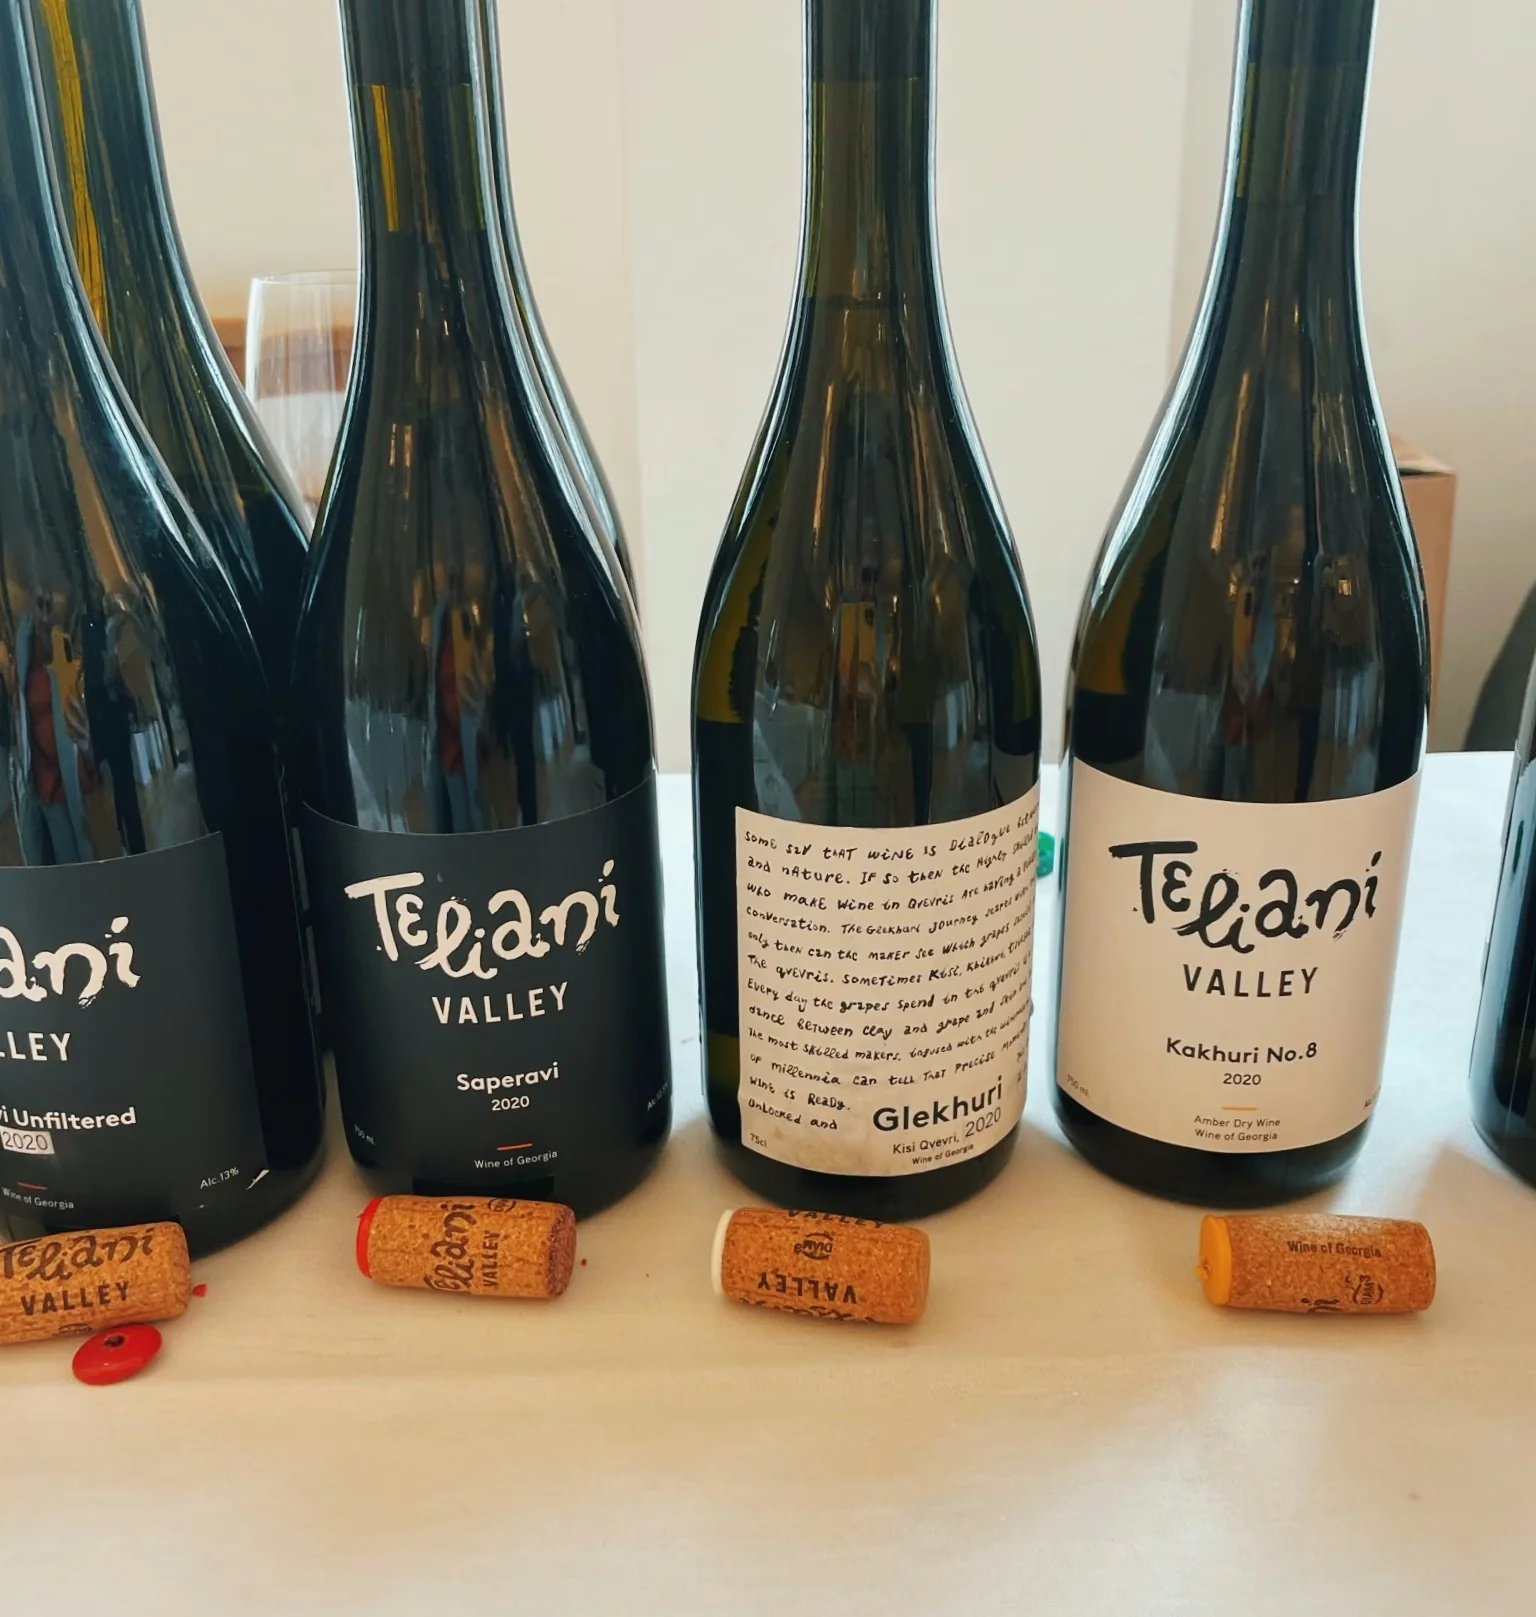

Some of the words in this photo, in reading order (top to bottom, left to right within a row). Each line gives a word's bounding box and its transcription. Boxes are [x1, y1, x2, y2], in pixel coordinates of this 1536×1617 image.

[747, 856, 771, 873] and
[952, 863, 970, 876] the
[882, 899, 900, 911] in
[748, 931, 770, 949] only
[808, 948, 832, 959] can
[837, 949, 858, 961] the
[980, 922, 1010, 948] grapes
[1183, 964, 1318, 998] VALLEY
[432, 981, 568, 1024] VALLEY
[747, 977, 779, 1001] Every
[785, 991, 808, 1013] day
[813, 996, 833, 1010] the
[840, 1001, 890, 1014] grapes
[942, 993, 958, 1005] in
[749, 1005, 785, 1025] dance
[862, 1025, 892, 1040] clay
[904, 1023, 928, 1035] and
[936, 1015, 970, 1034] grape
[976, 1001, 995, 1019] and
[0, 1030, 71, 1062] LEY
[768, 1035, 798, 1051] most
[909, 1042, 953, 1058] infused
[1166, 1037, 1259, 1063] Kakhuri
[1266, 1042, 1317, 1063] No.8
[457, 1061, 559, 1094] Saperavi
[771, 1061, 841, 1085] millennia
[852, 1075, 877, 1086] can
[1222, 1072, 1262, 1085] 2020
[491, 1096, 530, 1111] 2020
[873, 1075, 1002, 1132] Glekhuri
[12, 1106, 137, 1130] Unfiltered
[810, 1118, 838, 1130] and
[1193, 1115, 1231, 1127] Amber
[1234, 1119, 1253, 1130] Dry
[1256, 1118, 1281, 1127] Wine
[2, 1131, 48, 1151] 2020
[892, 1142, 917, 1155] Kisi
[919, 1133, 960, 1150] Qvevri,
[965, 1107, 1002, 1138] 2020
[1195, 1129, 1221, 1140] Wine
[1224, 1132, 1235, 1141] of
[1238, 1132, 1278, 1142] Georgia
[474, 1159, 500, 1169] Wine
[504, 1158, 514, 1167] of
[517, 1151, 558, 1165] Georgia
[912, 1156, 933, 1165] Wine
[934, 1152, 943, 1160] of
[945, 1143, 974, 1158] Georgia
[1, 1186, 22, 1201] Wine
[23, 1195, 32, 1204] of
[34, 1197, 74, 1210] Georgia
[424, 1203, 477, 1292] eliani
[482, 1230, 500, 1288] VALLEY
[1287, 1240, 1318, 1254] Wine
[1320, 1242, 1333, 1254] of
[1336, 1243, 1382, 1258] Georgia
[20, 1281, 130, 1316] VALLEY
[757, 1272, 857, 1304] VALLEY
